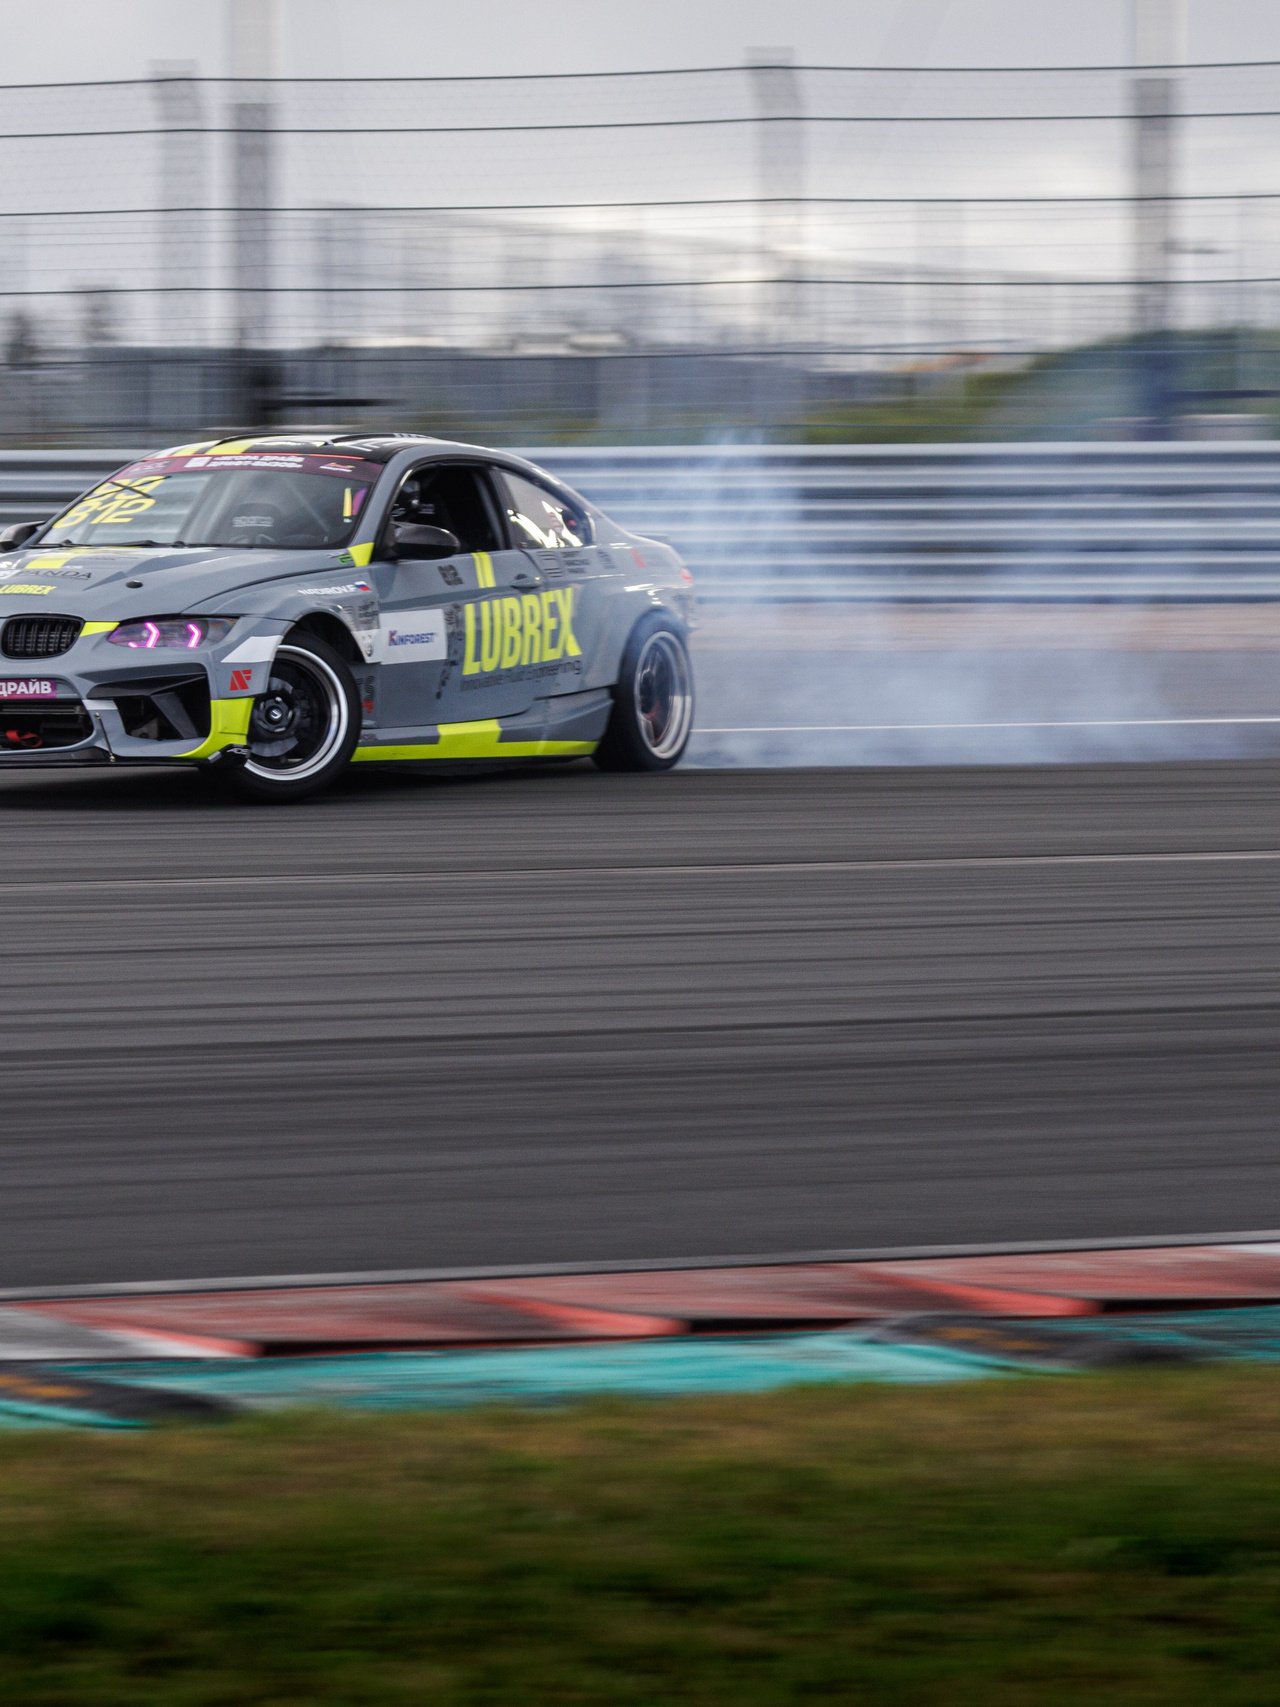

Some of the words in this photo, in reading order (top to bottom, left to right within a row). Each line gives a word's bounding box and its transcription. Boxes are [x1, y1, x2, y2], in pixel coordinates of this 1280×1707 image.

[52, 498, 156, 529] 812
[17, 569, 92, 579] PANDA
[388, 630, 435, 647] KINFOREST
[462, 588, 583, 675] LUBREX
